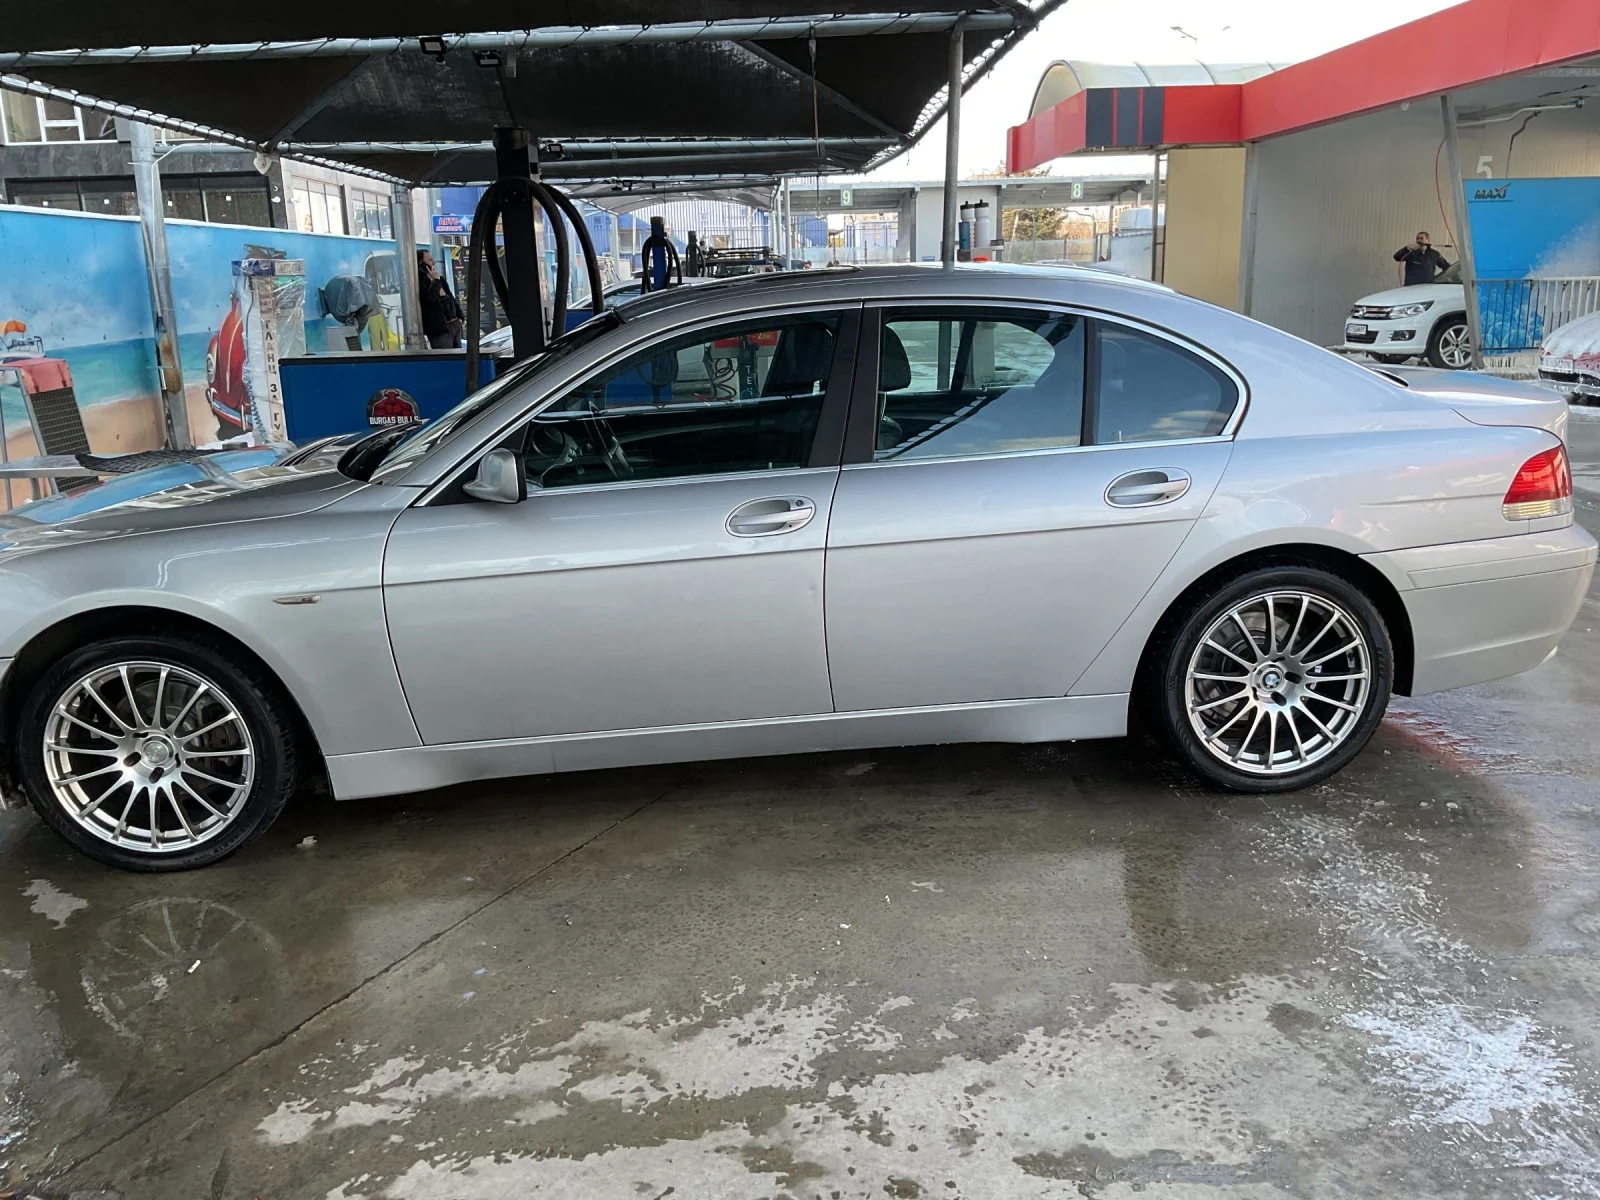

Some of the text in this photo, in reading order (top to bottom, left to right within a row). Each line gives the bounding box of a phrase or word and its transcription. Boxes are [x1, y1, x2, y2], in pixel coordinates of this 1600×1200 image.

[1476, 155, 1493, 179] 5
[843, 190, 850, 205] 9
[1073, 183, 1081, 198] 8
[369, 416, 396, 425] BURGAS
